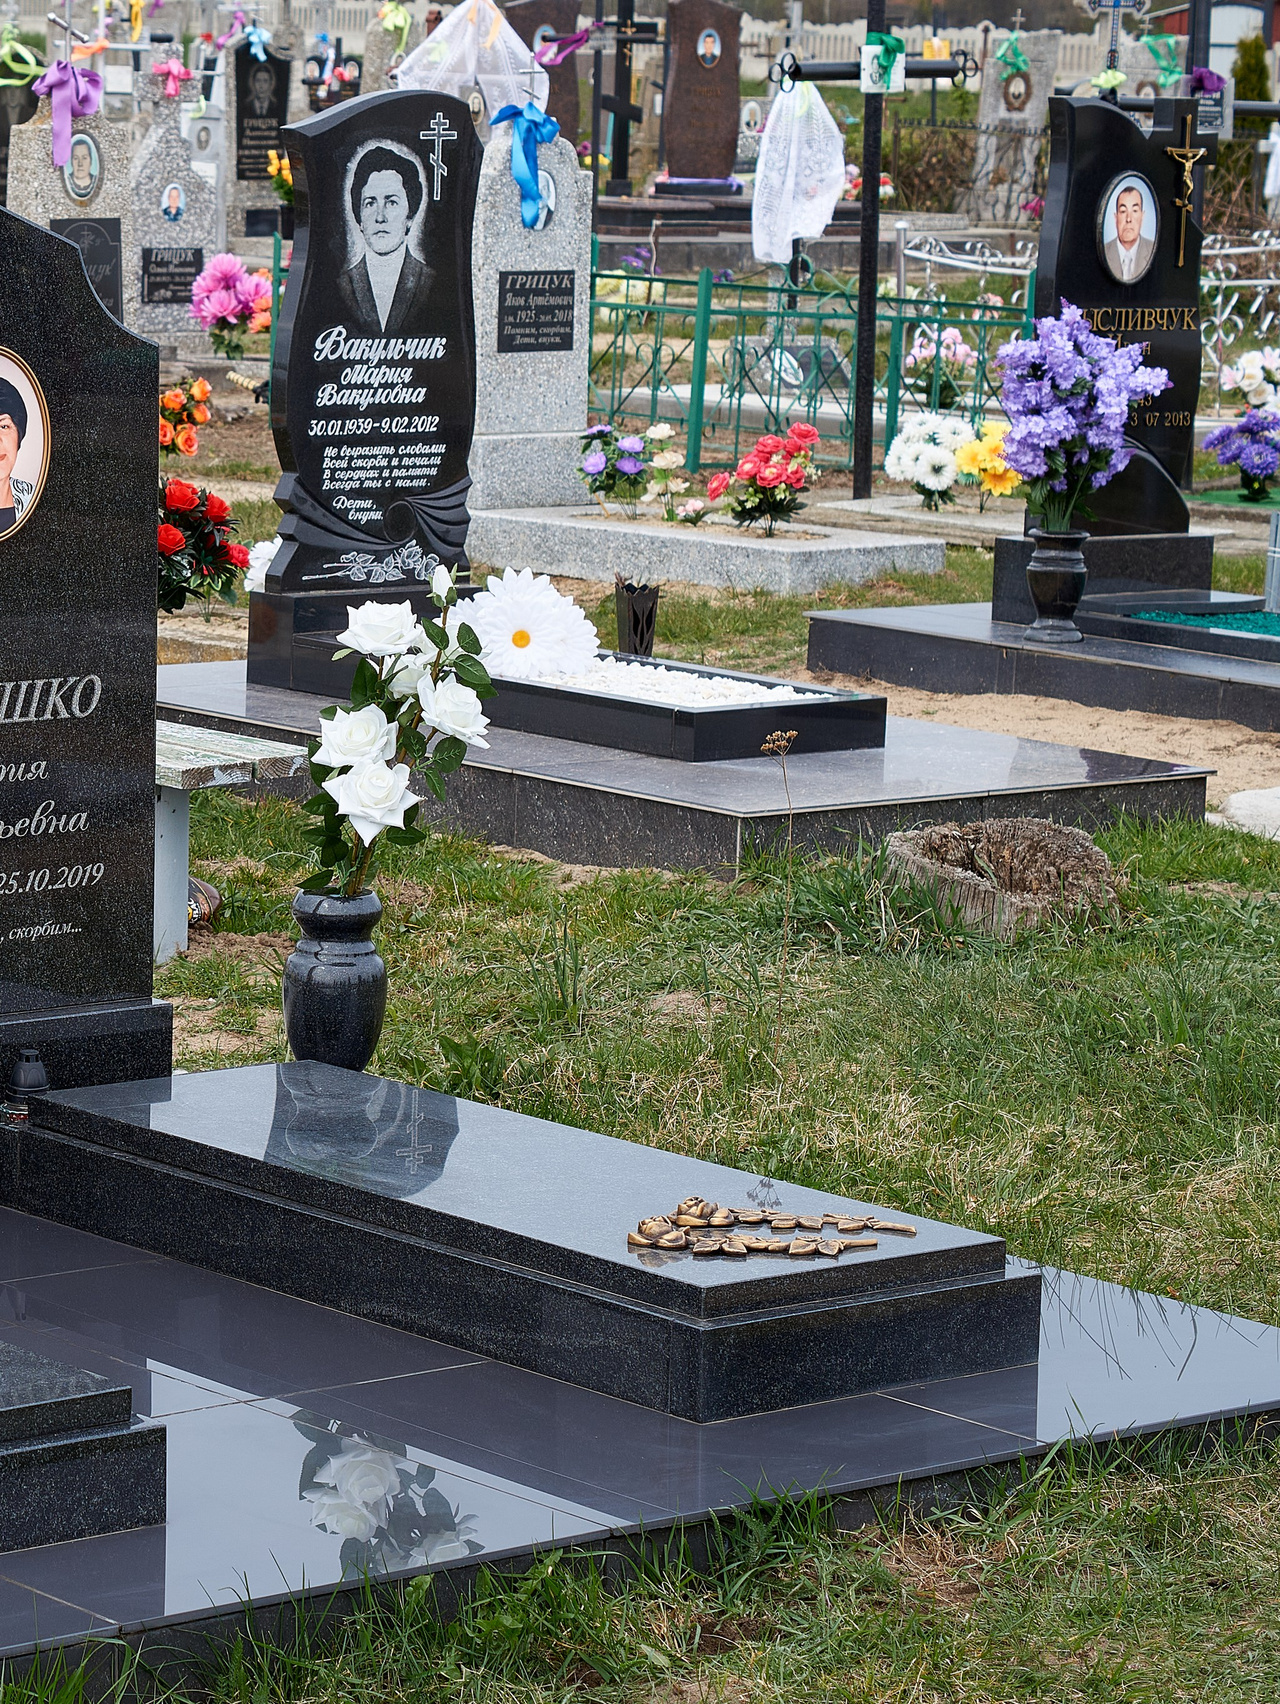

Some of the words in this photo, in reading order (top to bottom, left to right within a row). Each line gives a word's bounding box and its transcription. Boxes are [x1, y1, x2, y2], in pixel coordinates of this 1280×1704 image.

[505, 274, 574, 291] ГРИЦУК
[1082, 307, 1198, 331] ЫСЛИВЧУК
[313, 325, 448, 366] Вакульчик
[340, 363, 414, 387] Мария
[315, 383, 428, 411] Вакуловна
[1164, 411, 1191, 427] 2013
[323, 446, 339, 458] Не
[340, 444, 396, 459] выразить
[398, 442, 447, 454] словами
[322, 456, 349, 469] Всей
[351, 455, 389, 469] скорби
[390, 457, 399, 467] и
[401, 455, 442, 467] печали
[322, 468, 331, 480] В
[334, 468, 380, 480] сердцах
[381, 467, 390, 478] и
[391, 466, 438, 478] памяти
[322, 479, 361, 491] Всегда
[362, 479, 383, 489] ты
[384, 479, 392, 488] с
[394, 477, 431, 488] нами.
[332, 495, 377, 510] Дети,
[347, 508, 384, 525] внуки.
[8, 919, 83, 942] скорбим...
